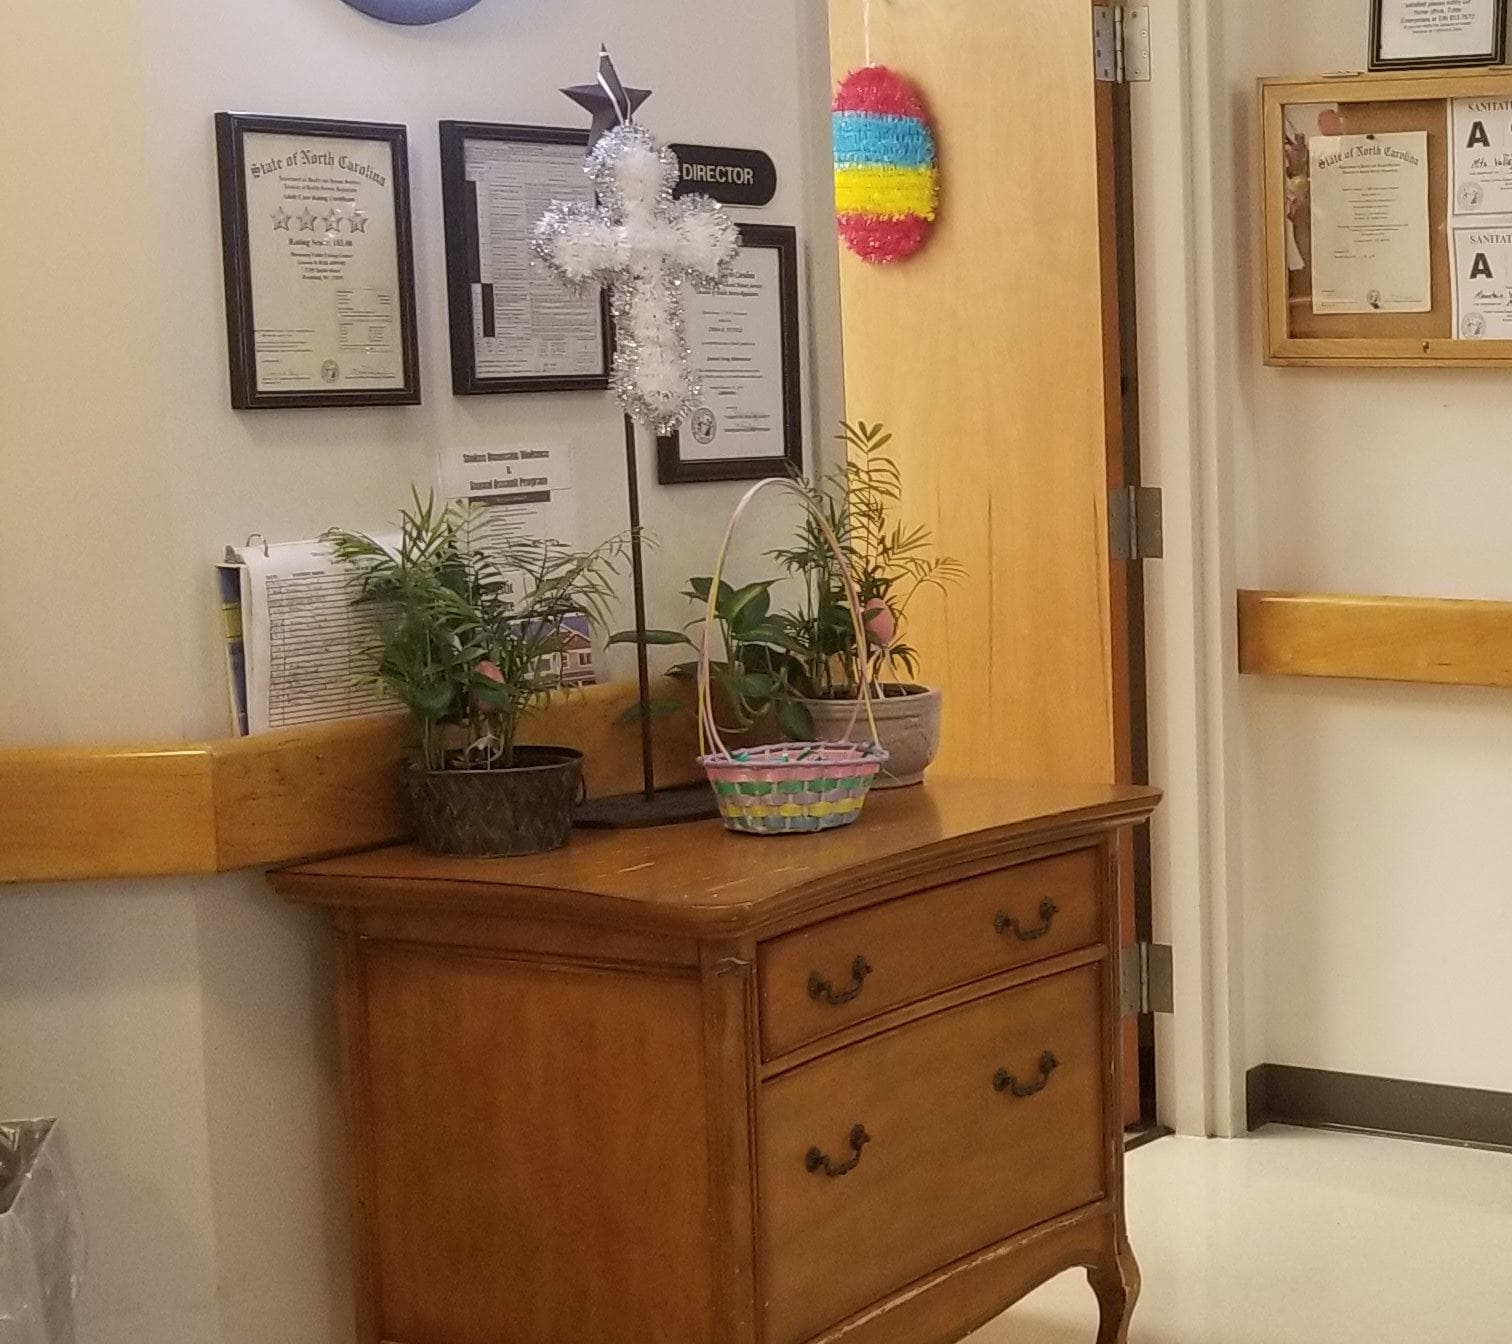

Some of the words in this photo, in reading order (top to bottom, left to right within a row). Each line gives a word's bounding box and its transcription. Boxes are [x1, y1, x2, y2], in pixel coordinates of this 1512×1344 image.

[1466, 121, 1491, 148] A
[250, 158, 283, 178] State
[286, 152, 299, 167] of
[300, 149, 335, 167] North
[338, 155, 386, 187] Carolina
[1318, 154, 1342, 169] State
[1344, 149, 1354, 159] of
[1356, 145, 1381, 157] North
[1384, 146, 1419, 166] Carolina
[682, 163, 754, 185] DIRECTOR
[1469, 252, 1494, 279] A
